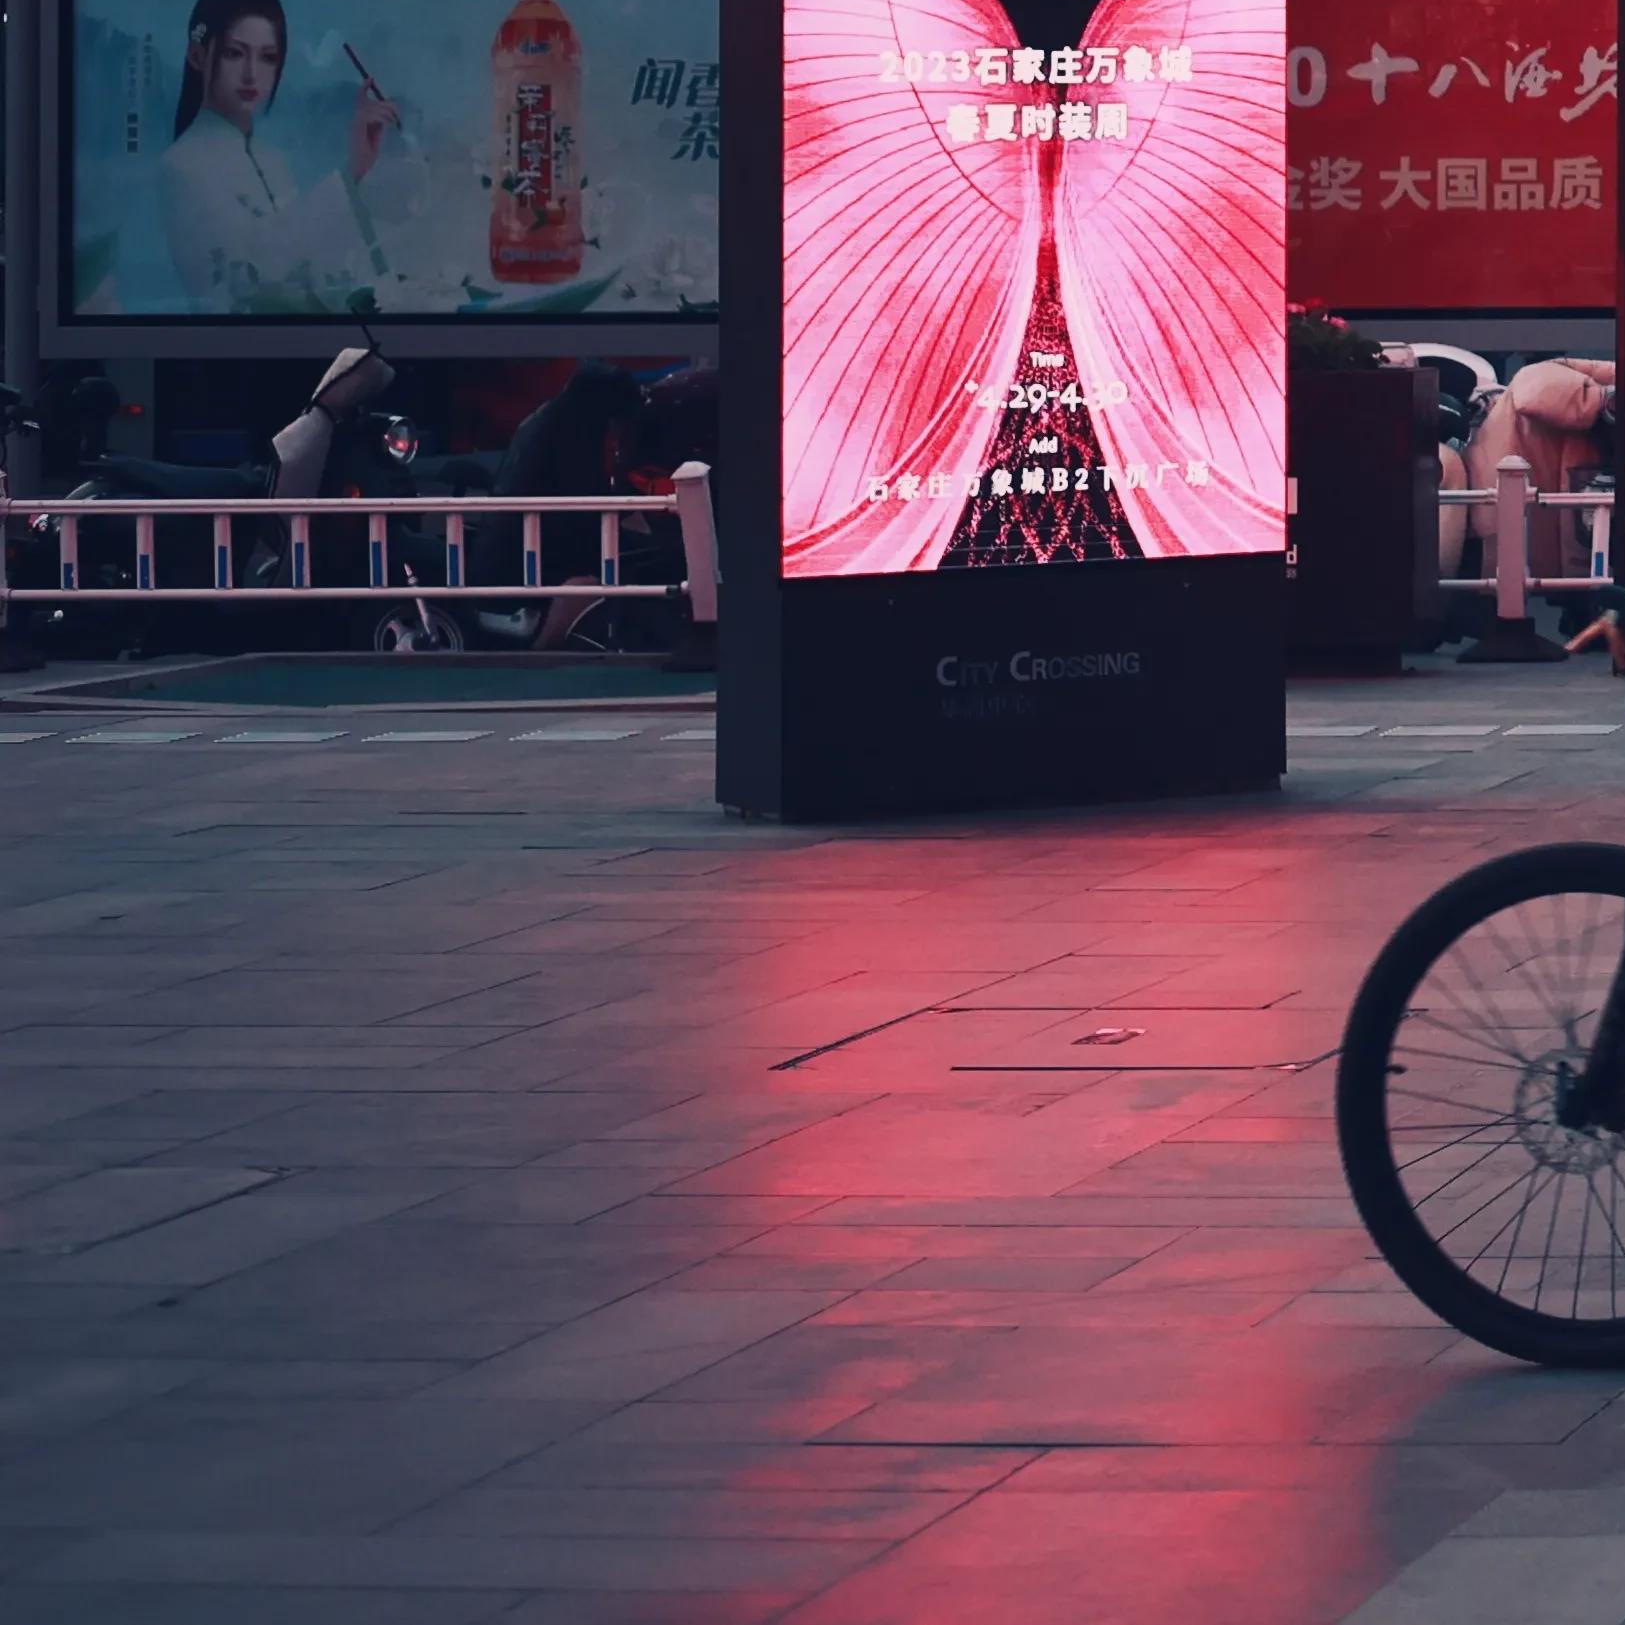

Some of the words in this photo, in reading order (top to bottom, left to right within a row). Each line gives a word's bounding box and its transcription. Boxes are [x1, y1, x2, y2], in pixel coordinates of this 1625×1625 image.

[879, 45, 1194, 88] 2023石家庄万象城
[946, 102, 1129, 143] 春夏时装周
[1379, 156, 1603, 211] 大国品质
[1029, 436, 1058, 454] Add
